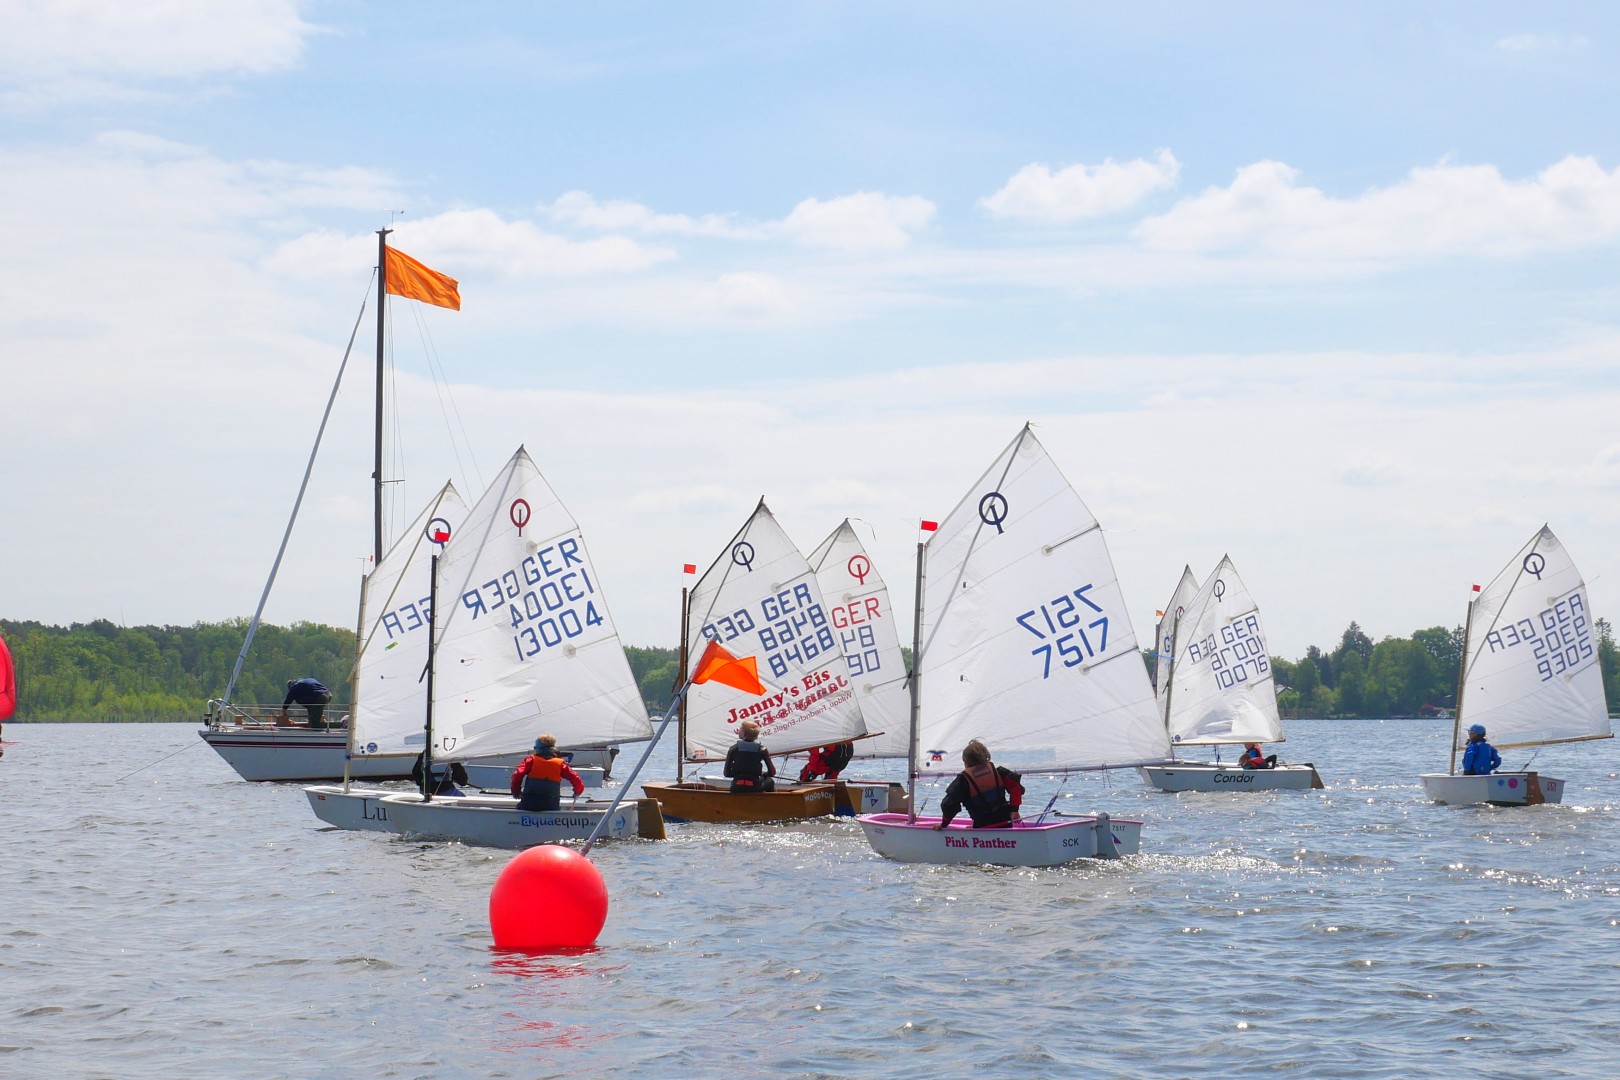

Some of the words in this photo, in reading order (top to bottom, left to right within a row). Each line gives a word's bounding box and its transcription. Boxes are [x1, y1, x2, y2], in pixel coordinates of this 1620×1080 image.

[521, 537, 583, 586] GER
[761, 582, 813, 622] GER
[831, 597, 881, 629] GER
[1539, 593, 1584, 631] GER
[513, 600, 604, 662] 13004
[1220, 615, 1259, 644] GER
[768, 625, 835, 678] 8468
[1031, 616, 1109, 680] 7517
[1537, 636, 1593, 682] 9305
[801, 669, 831, 691] Eis
[1214, 654, 1268, 690] 10076
[1213, 773, 1255, 783] Condor
[361, 798, 392, 821] Lu
[944, 836, 969, 848] Pink
[972, 836, 1017, 849] Panther
[1062, 838, 1079, 848] SCK
